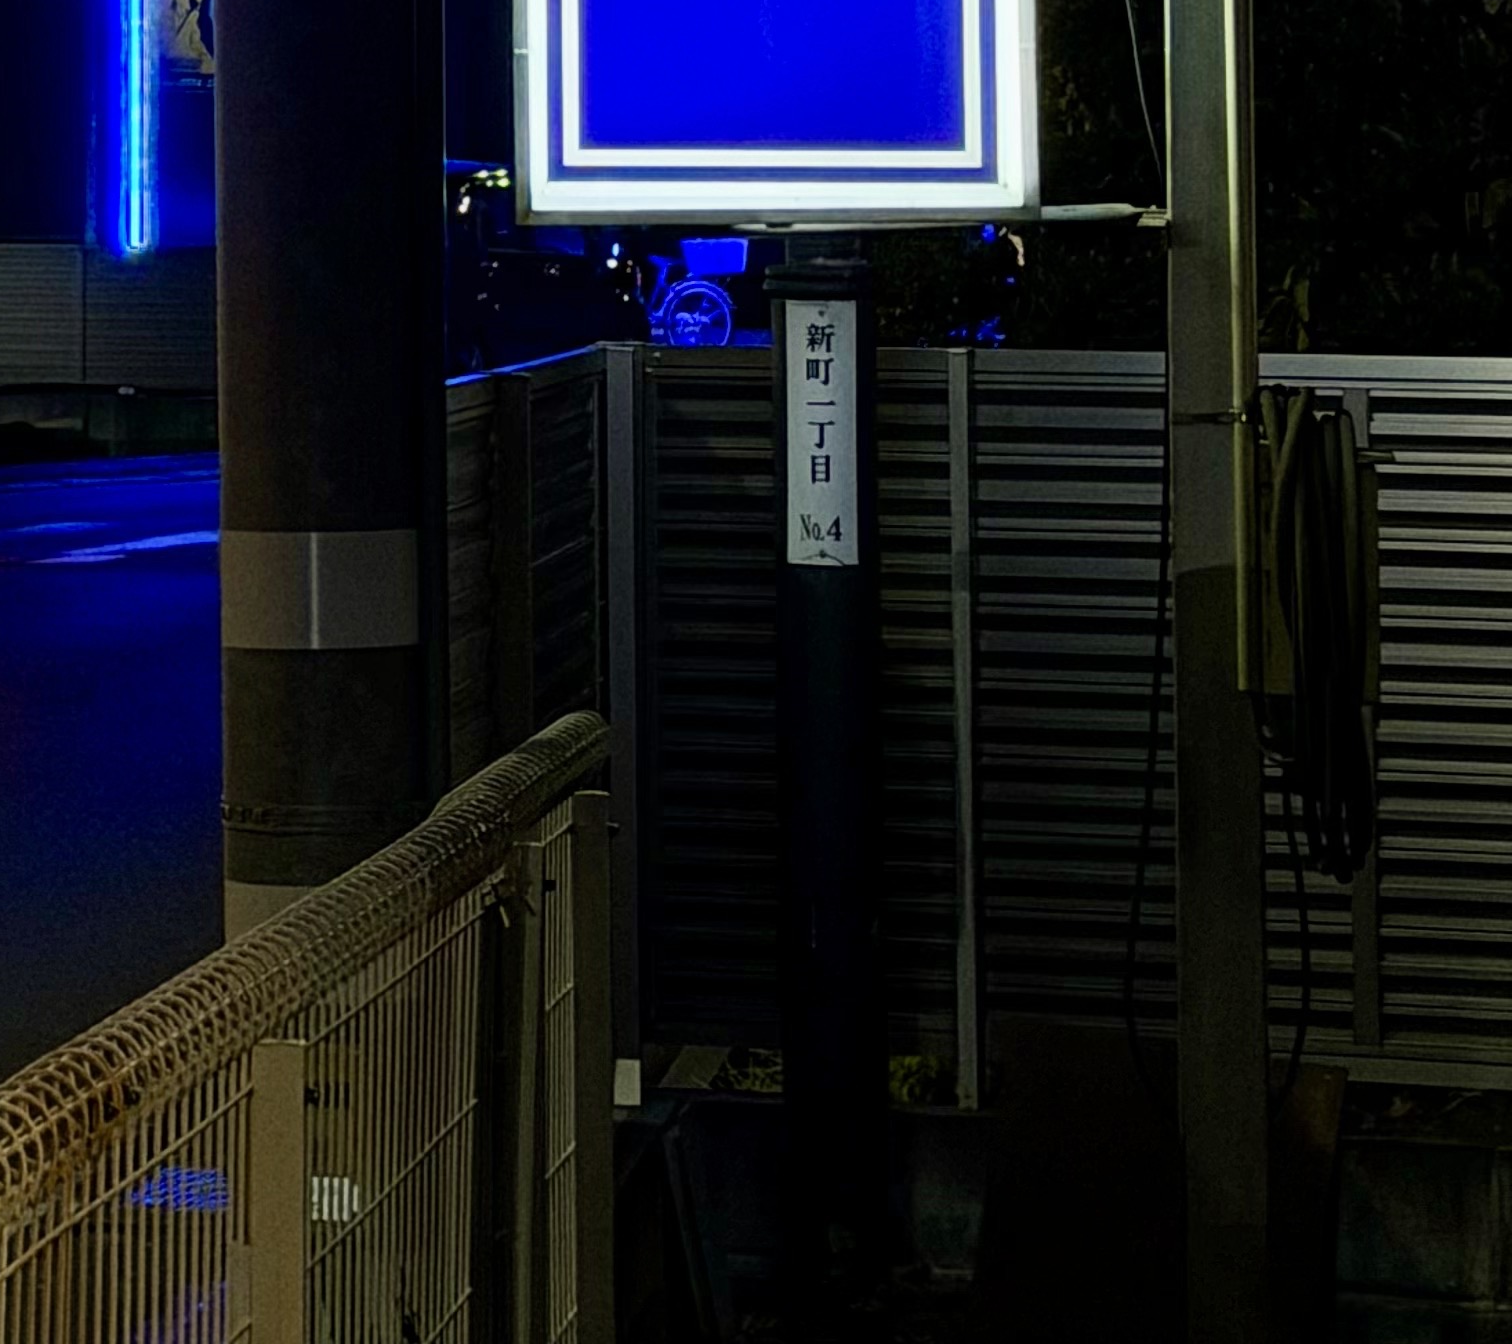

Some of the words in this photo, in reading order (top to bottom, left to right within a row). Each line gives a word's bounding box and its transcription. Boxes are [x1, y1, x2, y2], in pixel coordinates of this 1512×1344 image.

[804, 322, 837, 485] 新町一丁目
